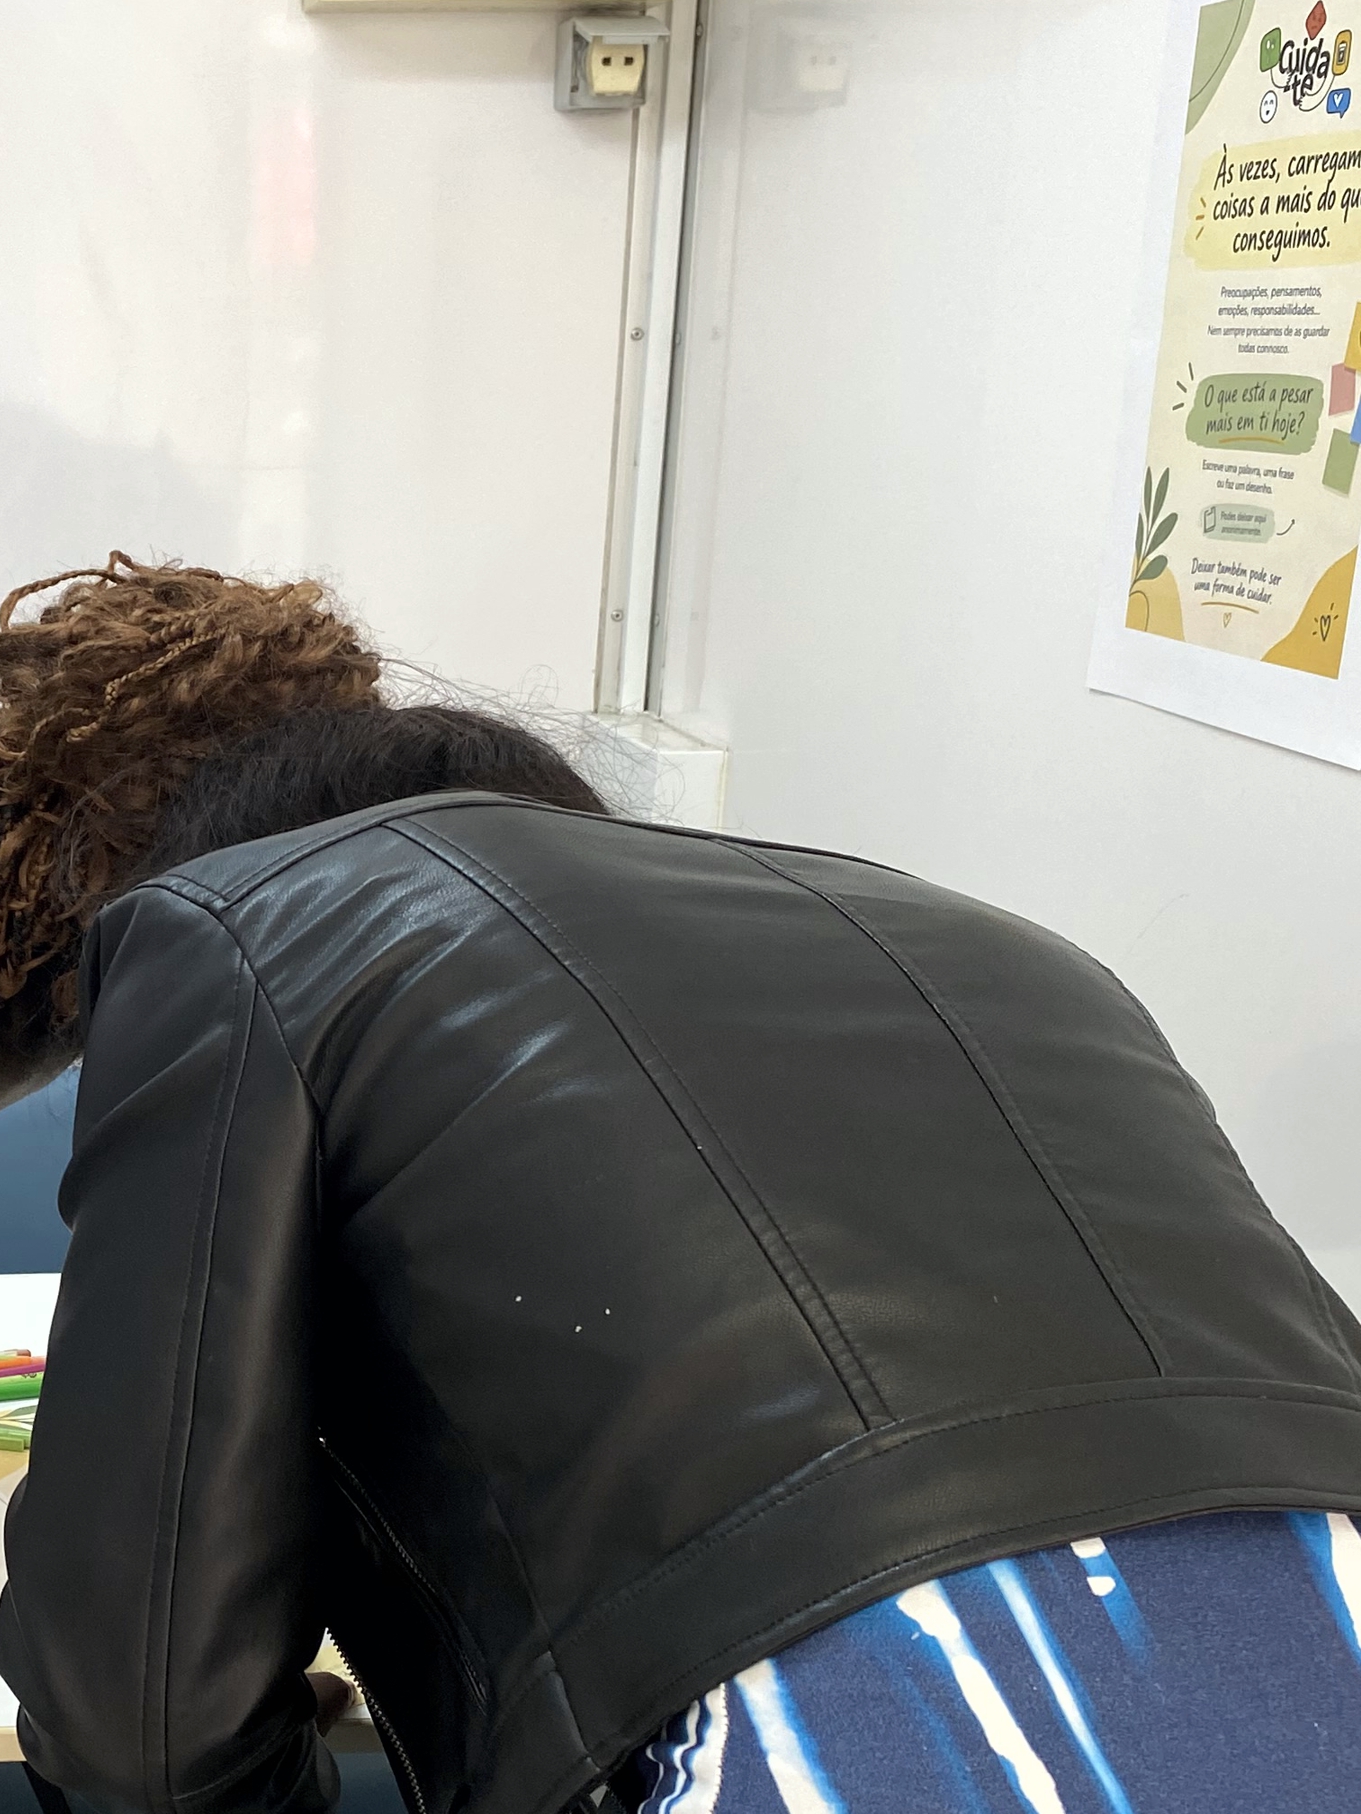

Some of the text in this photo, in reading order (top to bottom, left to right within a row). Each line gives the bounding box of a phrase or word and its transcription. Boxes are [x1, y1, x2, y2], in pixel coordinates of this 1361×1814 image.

[1279, 38, 1330, 78] Cuida
[1214, 143, 1234, 190] Às
[1240, 158, 1280, 183] vezes,
[1213, 180, 1361, 223] coisas a mais do qu
[1233, 222, 1330, 262] conseguimos.
[1270, 285, 1322, 299] pensamentos,
[1207, 325, 1330, 339] Nem sempre precisamos de as guardar
[1204, 381, 1314, 413] O que está a pesar
[1206, 410, 1305, 441] mais em ti hoje?
[1202, 459, 1224, 471] Escreve
[1224, 464, 1238, 474] uma
[1263, 469, 1277, 478] uma
[1278, 467, 1294, 479] frase
[1217, 479, 1224, 488] ou
[1225, 478, 1235, 489] faz
[1235, 482, 1245, 490] um
[1191, 557, 1282, 585] Deixar também pode ser
[1194, 578, 1272, 605] uma forma de cuidar.
